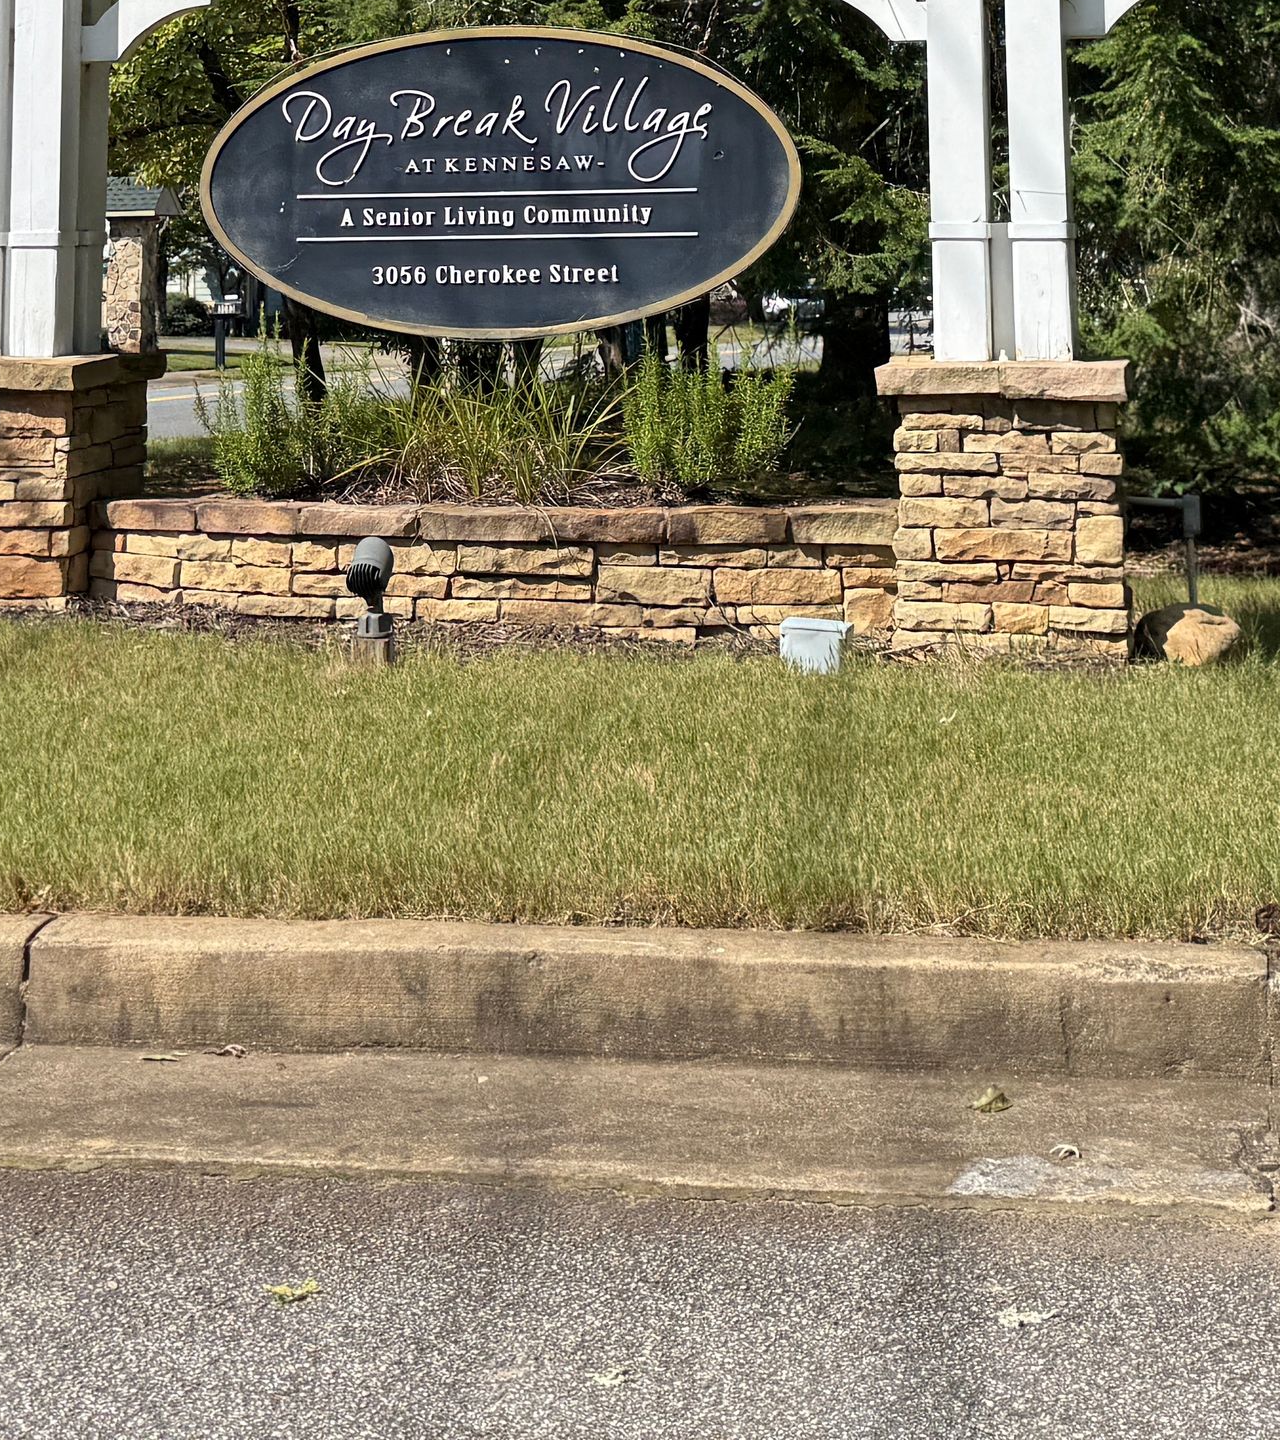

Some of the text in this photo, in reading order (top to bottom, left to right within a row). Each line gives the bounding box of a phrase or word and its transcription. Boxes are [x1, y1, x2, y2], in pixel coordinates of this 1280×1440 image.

[282, 76, 713, 186] Day Break Village
[404, 158, 436, 174] AT
[340, 203, 652, 227] A Senior Living Community
[371, 263, 620, 285] 3056 Cherokee Street
